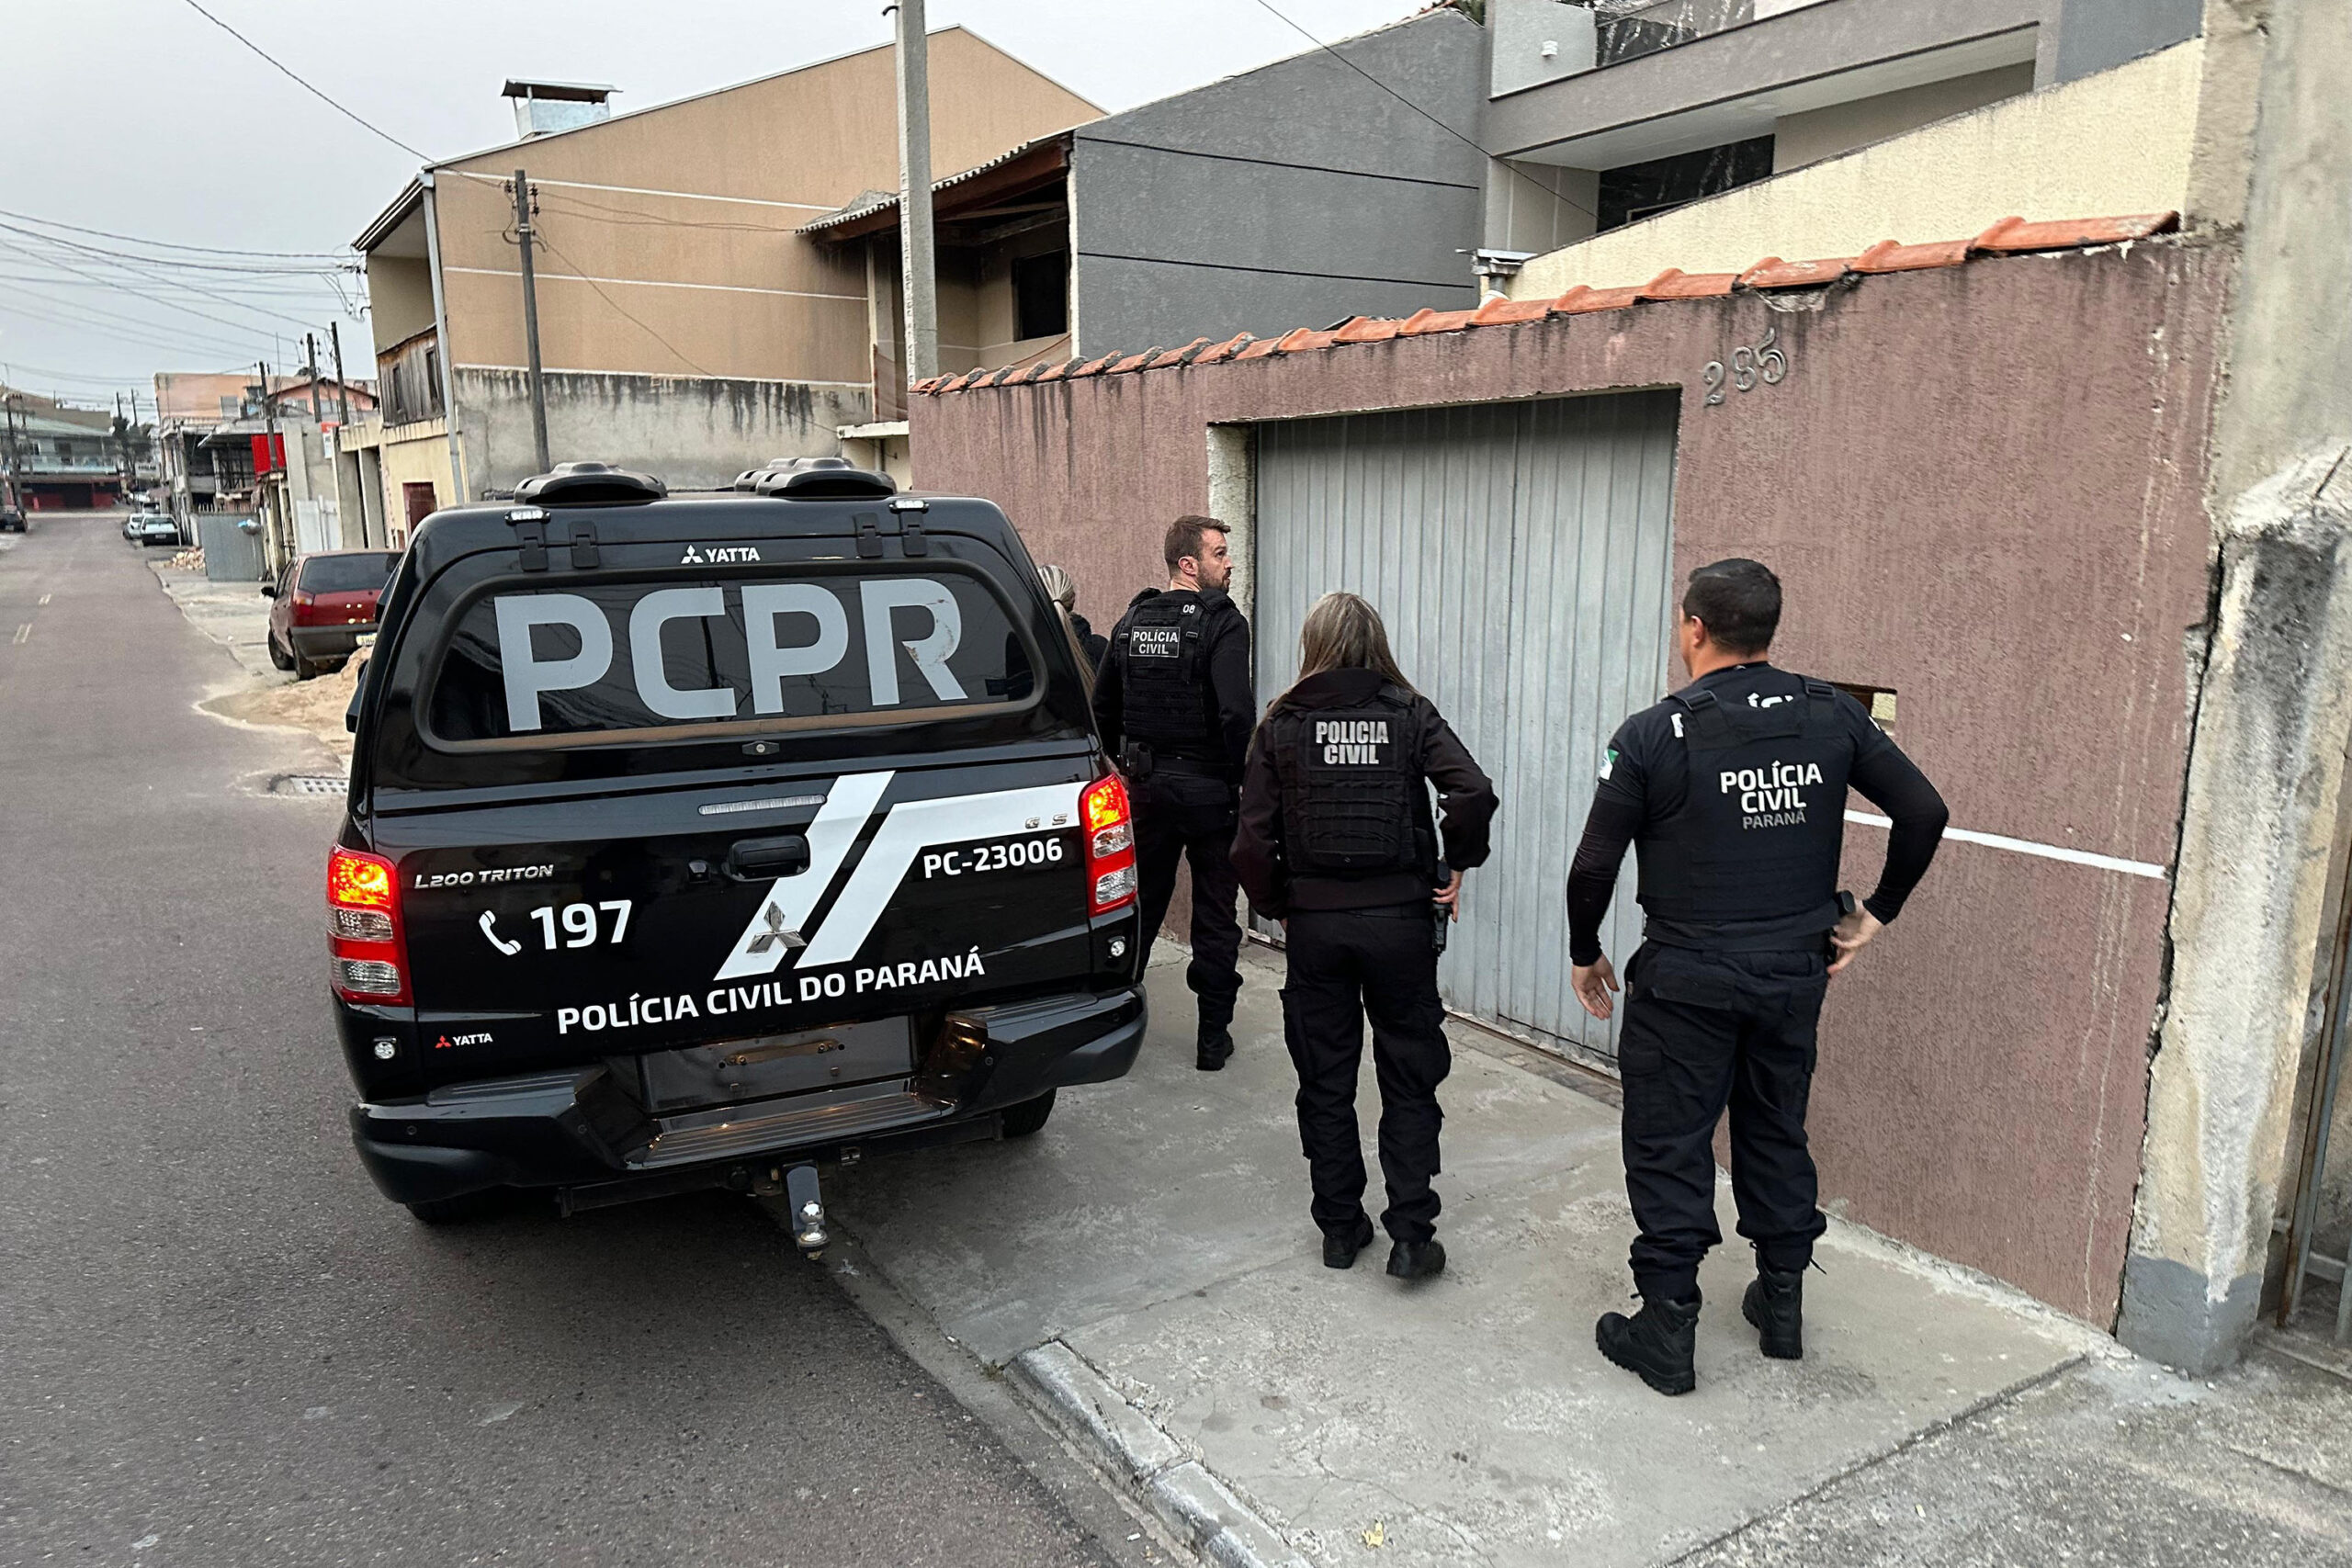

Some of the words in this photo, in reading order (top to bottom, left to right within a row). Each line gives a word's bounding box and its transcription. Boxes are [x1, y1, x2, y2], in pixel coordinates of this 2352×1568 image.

[1702, 326, 1787, 408] 285
[705, 547, 761, 563] YATTA
[1182, 604, 1196, 615] 08
[1132, 628, 1179, 643] POLÍCIA
[493, 578, 968, 732] PCPR
[1138, 643, 1170, 655] CIVIL
[1315, 720, 1390, 744] POLICIA
[1323, 744, 1380, 765] CIVIL
[1720, 760, 1824, 794] POLÍCIA
[1741, 787, 1807, 813] CIVIL
[1742, 809, 1807, 829] PARANÁ
[922, 837, 1064, 879] PC-23006
[414, 872, 474, 889] L200
[479, 864, 554, 883] TRITON
[530, 899, 634, 951] 197
[557, 992, 701, 1035] POLÍCIA
[706, 981, 793, 1016] CIVIL
[799, 973, 846, 1002] DO
[855, 944, 986, 994] PARANÁ
[452, 1032, 494, 1047] YATTA
